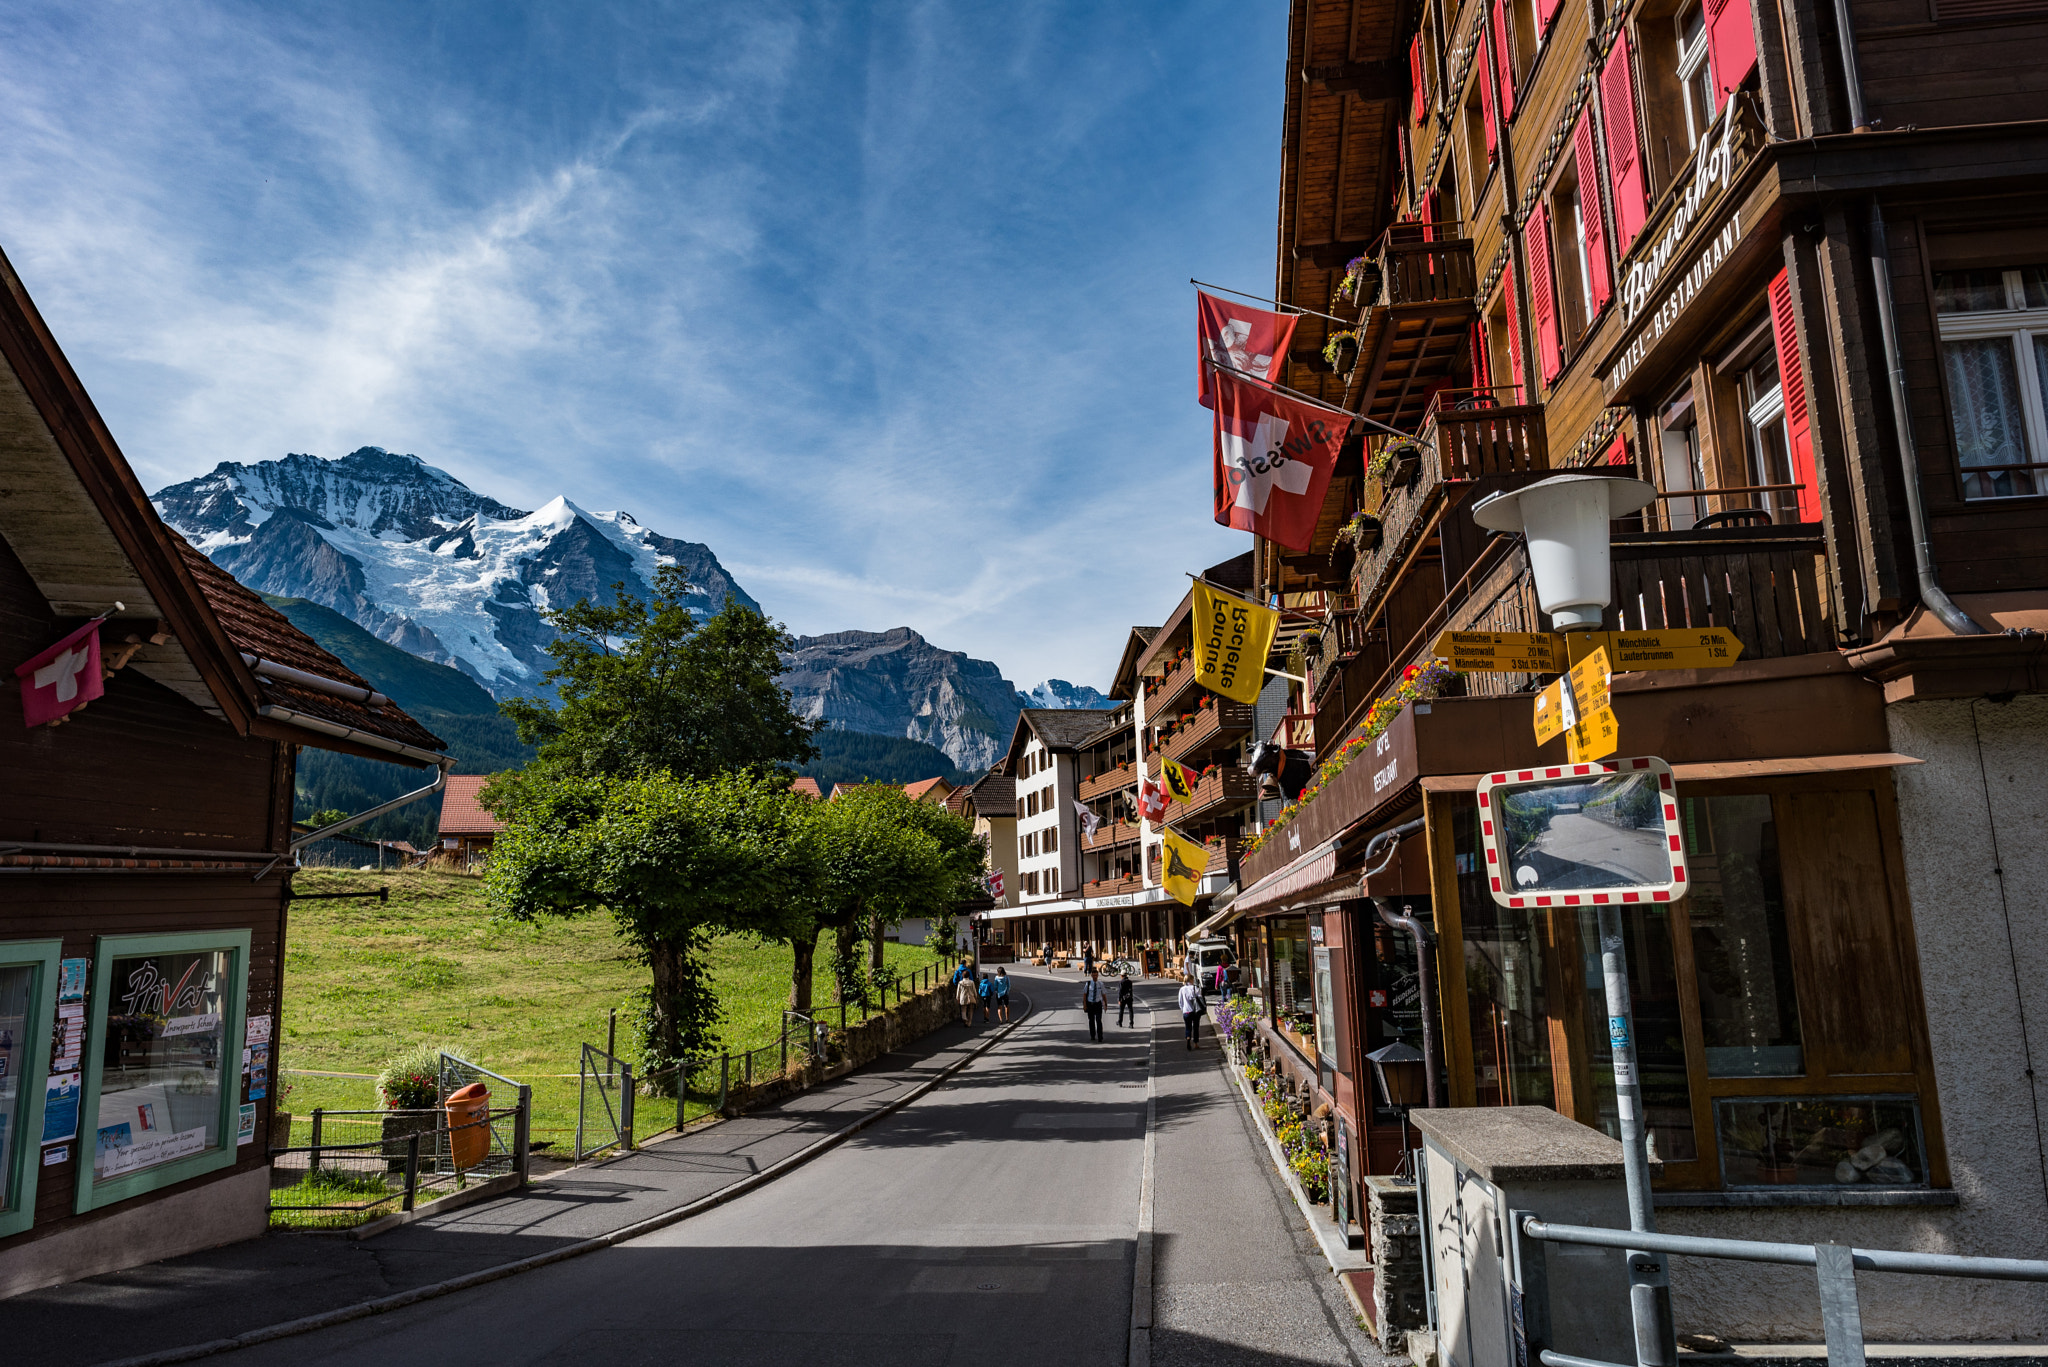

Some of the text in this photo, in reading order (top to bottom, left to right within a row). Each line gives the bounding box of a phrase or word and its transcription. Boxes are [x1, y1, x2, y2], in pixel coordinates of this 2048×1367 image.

[1624, 92, 1738, 327] Bernerhof
[1654, 210, 1742, 340] RESTAURANT
[1452, 632, 1549, 644] Männlichen 5 Min.
[1618, 635, 1727, 648] Mönchblick 25 Min.
[1453, 645, 1551, 657] Steinenwald 20 Min.
[1620, 650, 1674, 662] Lauterbrunnen
[1714, 648, 1728, 657] Std.
[1455, 658, 1494, 669] Männlichen
[1511, 659, 1517, 669] 3
[1539, 660, 1553, 670] Min.
[165, 1016, 214, 1034] Snowsports School
